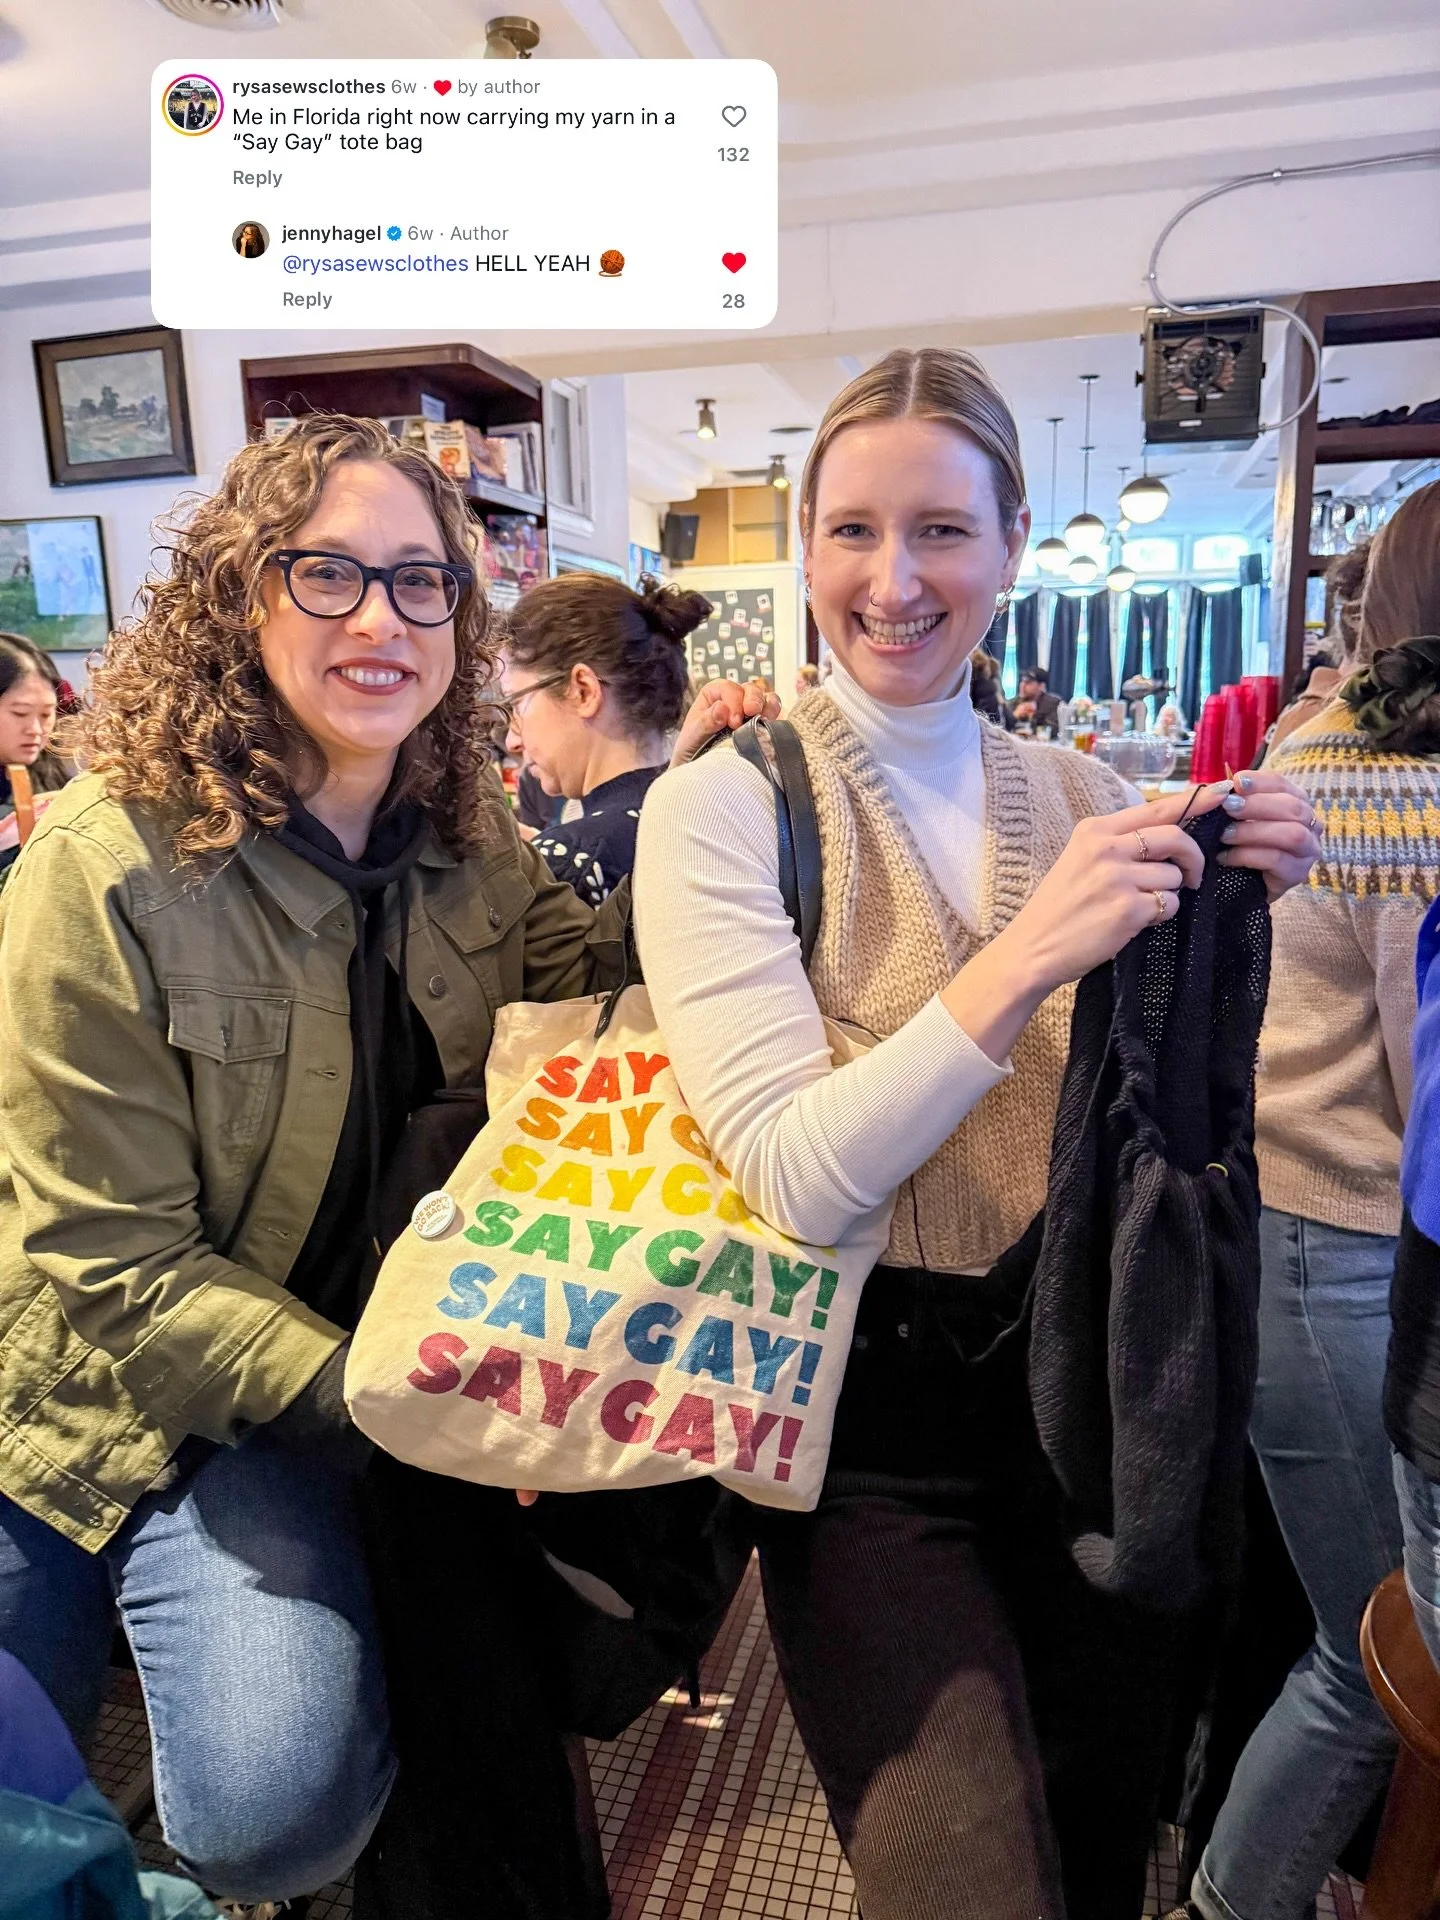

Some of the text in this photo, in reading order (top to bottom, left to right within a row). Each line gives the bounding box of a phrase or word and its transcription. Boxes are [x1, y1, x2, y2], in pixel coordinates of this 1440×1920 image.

[516, 1097, 664, 1157] SAY
[536, 1052, 670, 1104] SAY
[490, 1143, 655, 1213] SAY
[463, 1201, 840, 1331] SAY GAY!
[436, 1262, 823, 1407] SAY GAY!
[407, 1332, 804, 1482] SAY GAY!
